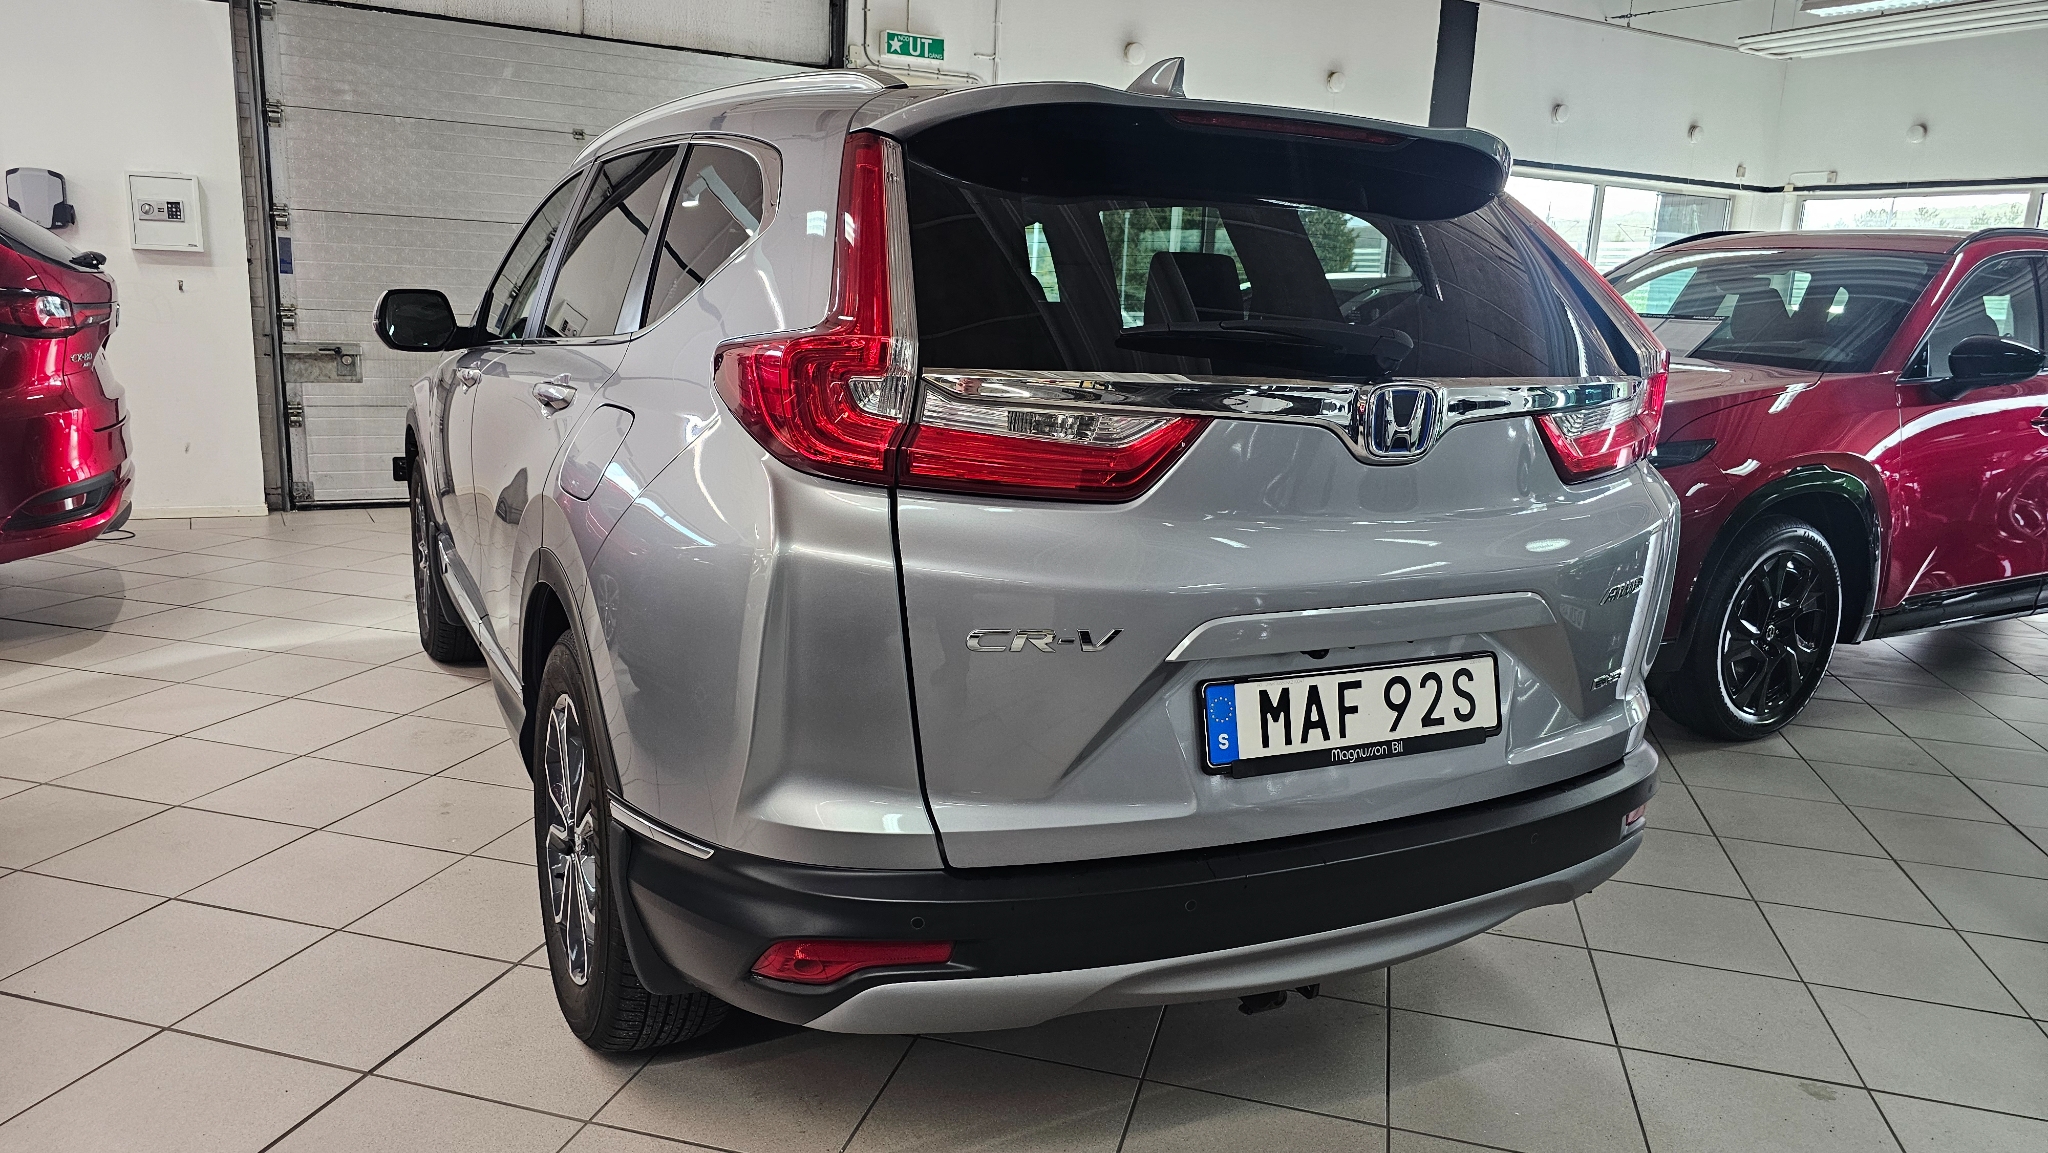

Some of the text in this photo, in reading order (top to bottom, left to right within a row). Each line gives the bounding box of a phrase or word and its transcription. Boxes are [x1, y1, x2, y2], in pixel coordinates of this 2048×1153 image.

[909, 36, 932, 58] UT
[70, 352, 93, 363] CX-80
[965, 628, 1124, 653] CR-V
[1258, 667, 1478, 749] MAF 92S
[1217, 733, 1230, 750] S
[1331, 740, 1404, 763] Magnusson Bil
